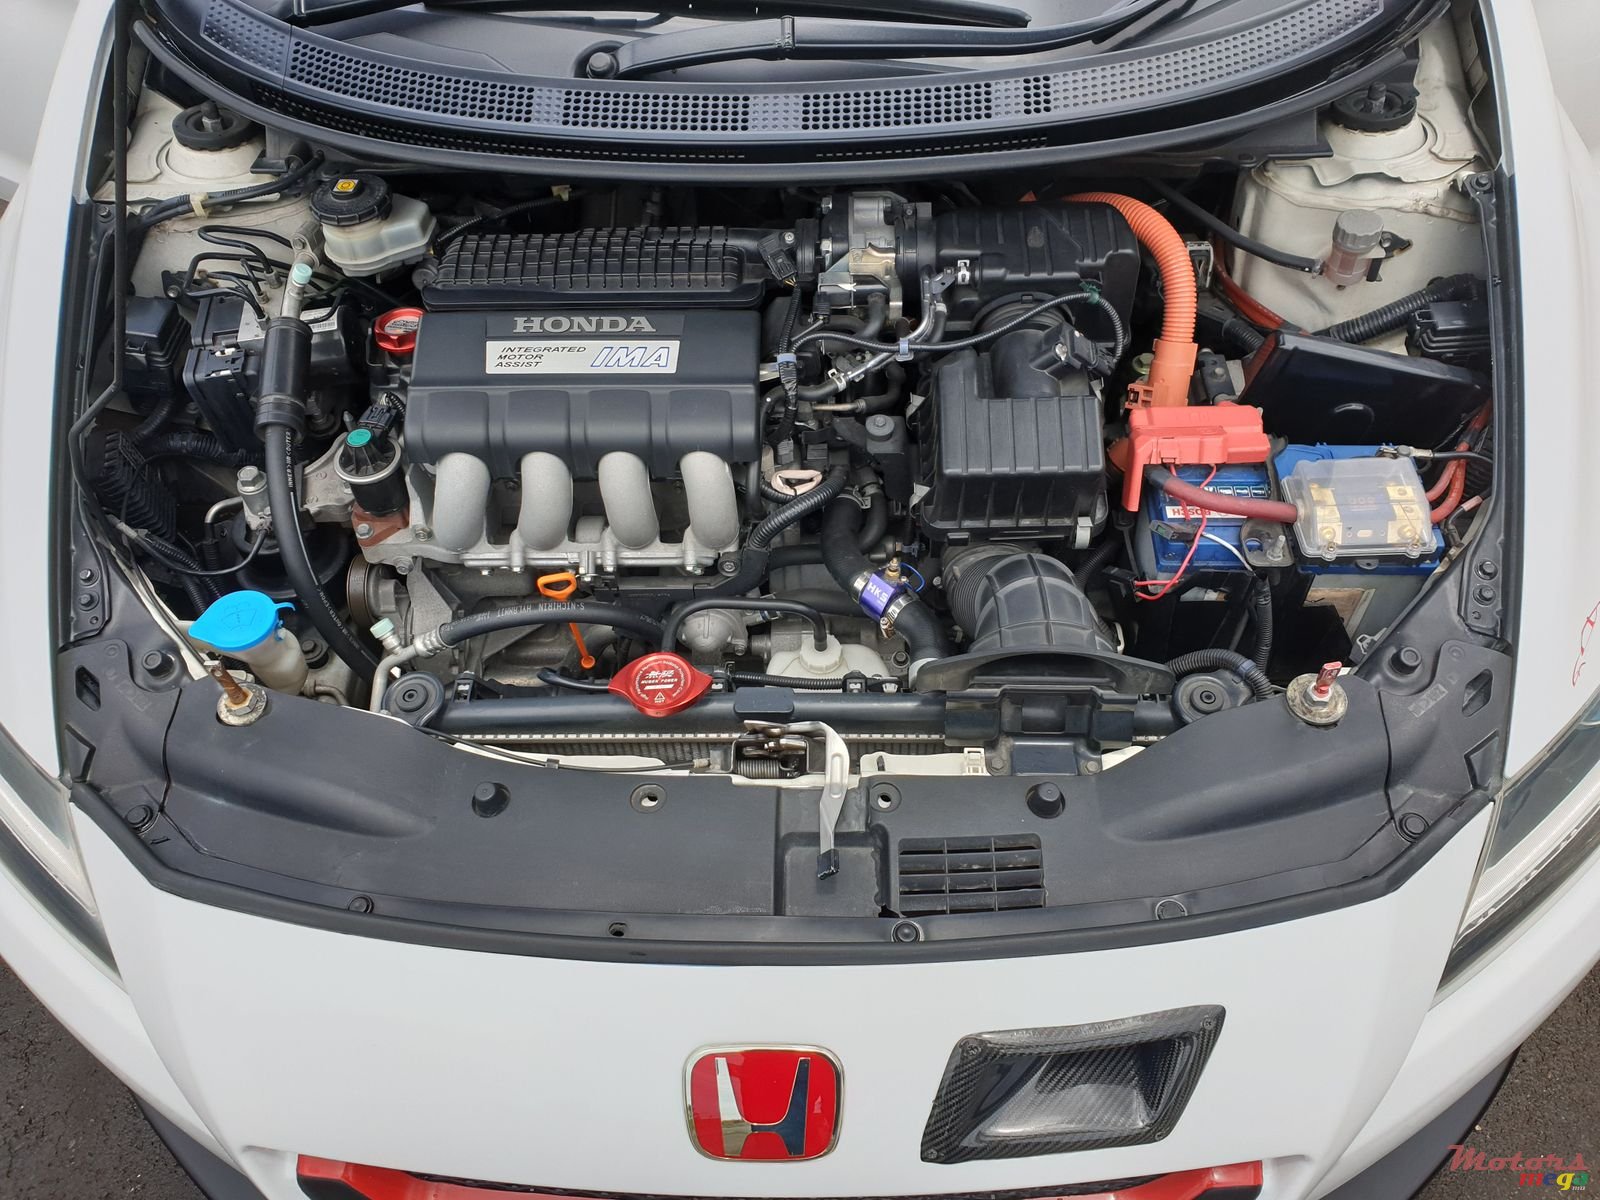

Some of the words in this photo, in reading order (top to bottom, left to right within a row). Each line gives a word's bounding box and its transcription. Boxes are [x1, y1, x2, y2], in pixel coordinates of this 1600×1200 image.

[512, 316, 656, 333] HONDA
[590, 346, 671, 368] IMA
[867, 582, 889, 603] HKS
